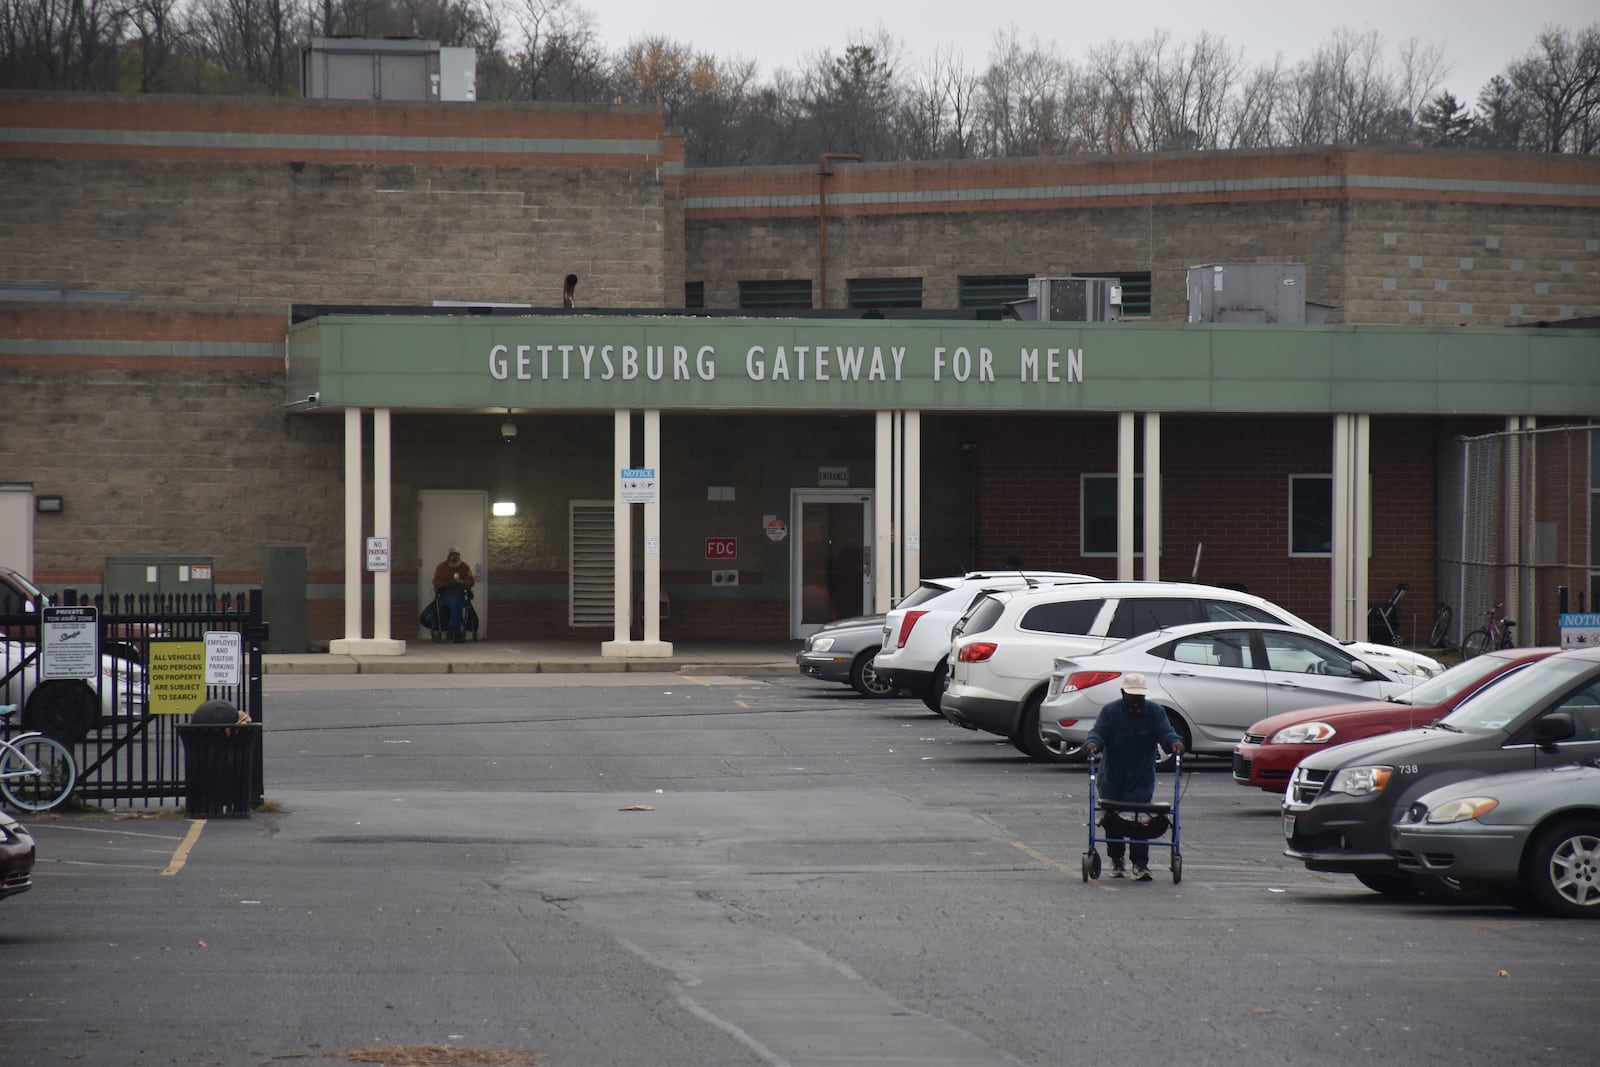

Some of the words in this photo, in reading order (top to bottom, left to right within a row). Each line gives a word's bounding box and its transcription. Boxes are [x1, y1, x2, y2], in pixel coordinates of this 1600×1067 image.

[488, 344, 716, 381] GETTYSBURG
[745, 345, 907, 382] GATEWAY
[932, 346, 995, 383] FOR
[1019, 346, 1084, 383] MEN
[819, 471, 848, 481] ENTRANCE
[707, 542, 735, 555] FDC
[1399, 764, 1418, 774] 738
